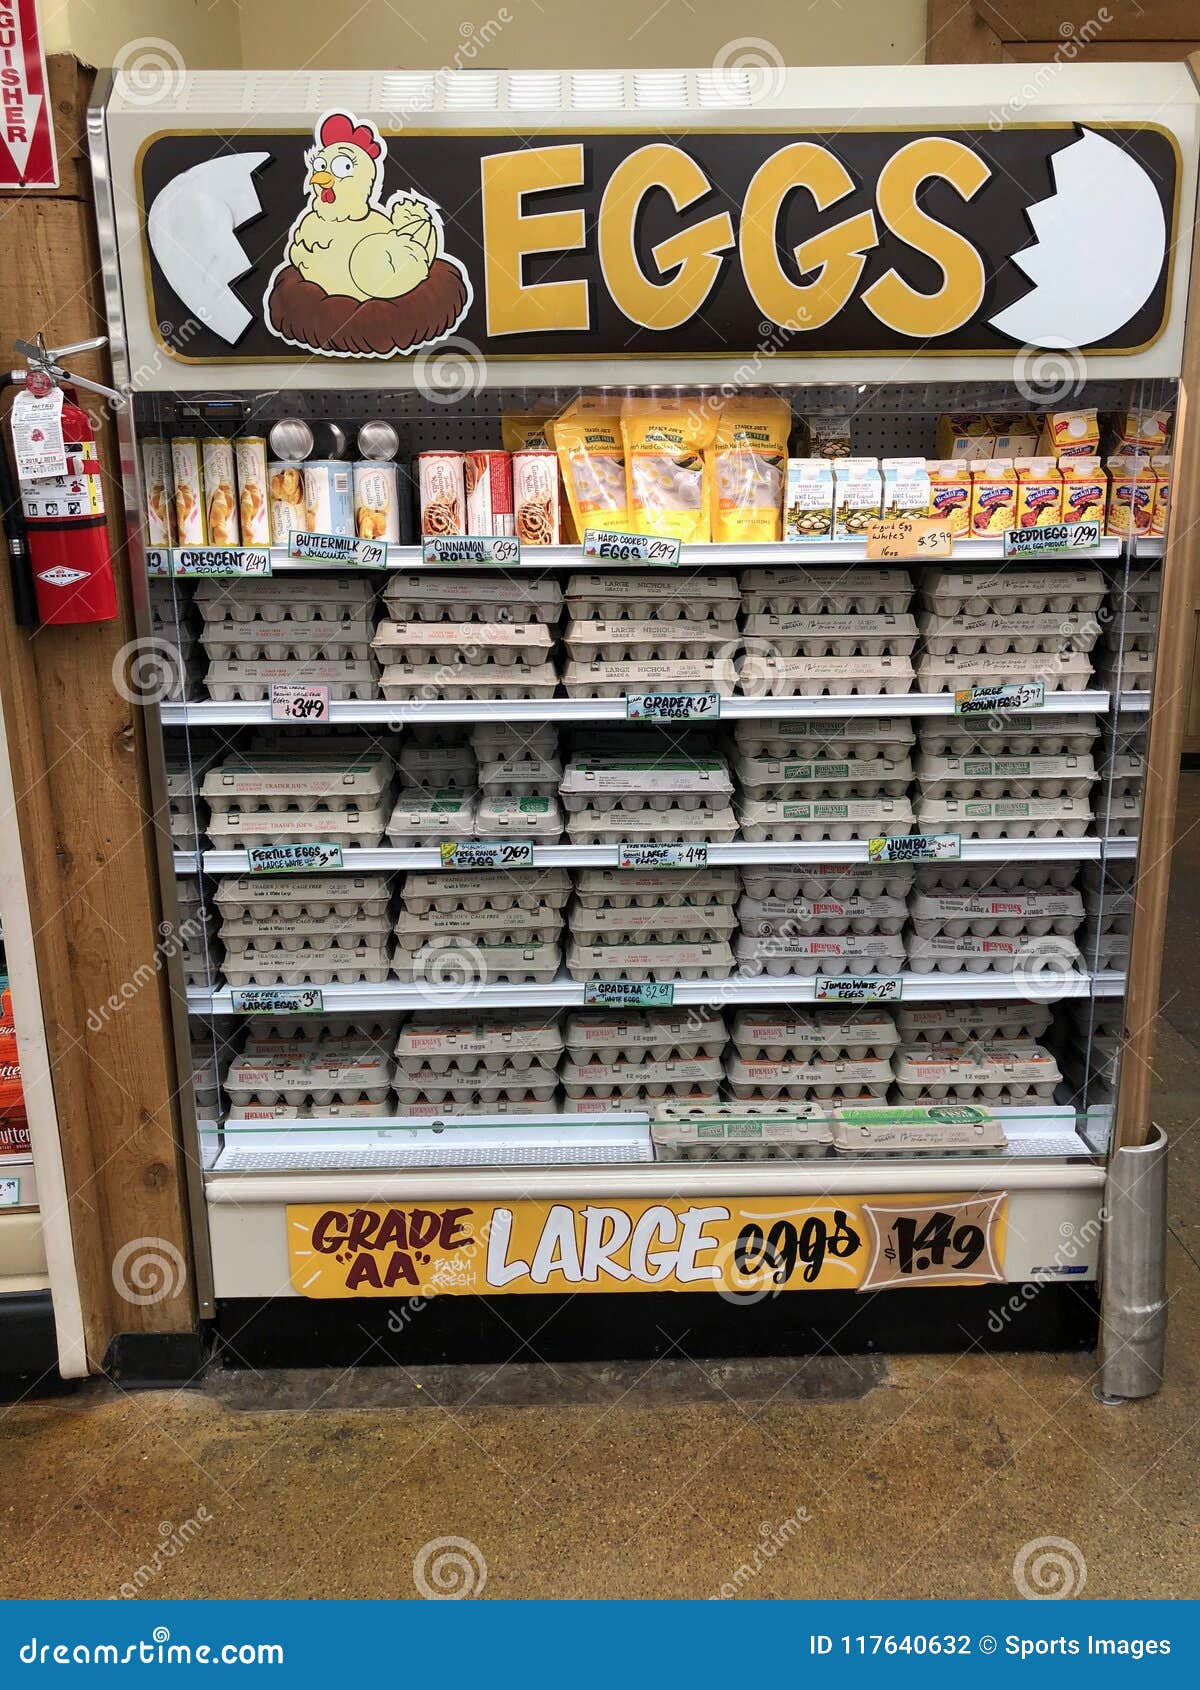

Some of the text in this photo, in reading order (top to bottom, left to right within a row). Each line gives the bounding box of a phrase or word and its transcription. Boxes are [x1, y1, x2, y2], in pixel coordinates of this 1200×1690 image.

[481, 136, 993, 338] EGGS
[620, 535, 648, 547] COOKED
[1009, 526, 1098, 546] REDDIEGG 2.99
[296, 533, 360, 552] BUTTERMILK
[361, 544, 383, 563] 2.99
[434, 539, 485, 552] CINNAMON
[493, 540, 518, 560] 3.99
[600, 541, 676, 559] EGGS 2.99
[180, 551, 245, 567] CRESCENT
[245, 553, 267, 571] 2.49
[439, 552, 485, 561] ROLLS
[195, 567, 234, 575] ROLLS
[974, 687, 1003, 697] LARGE
[643, 696, 685, 709] GRADE
[960, 695, 1021, 713] BROWN EGGS
[659, 708, 690, 718] EGGS
[887, 838, 926, 851] JUMBO
[251, 849, 292, 862] FERTILE
[294, 847, 320, 858] EGGS
[641, 849, 669, 858] LARGE
[888, 850, 920, 860] EGGS
[598, 983, 629, 993] GRADE
[821, 981, 853, 990] JUMBO
[240, 991, 260, 999] CAGE
[243, 1000, 298, 1010] LARGE EGGS
[312, 1207, 475, 1254] GRADE
[485, 1204, 731, 1289] LARGE
[734, 1210, 862, 1283] eggs
[432, 1257, 472, 1272] FARM
